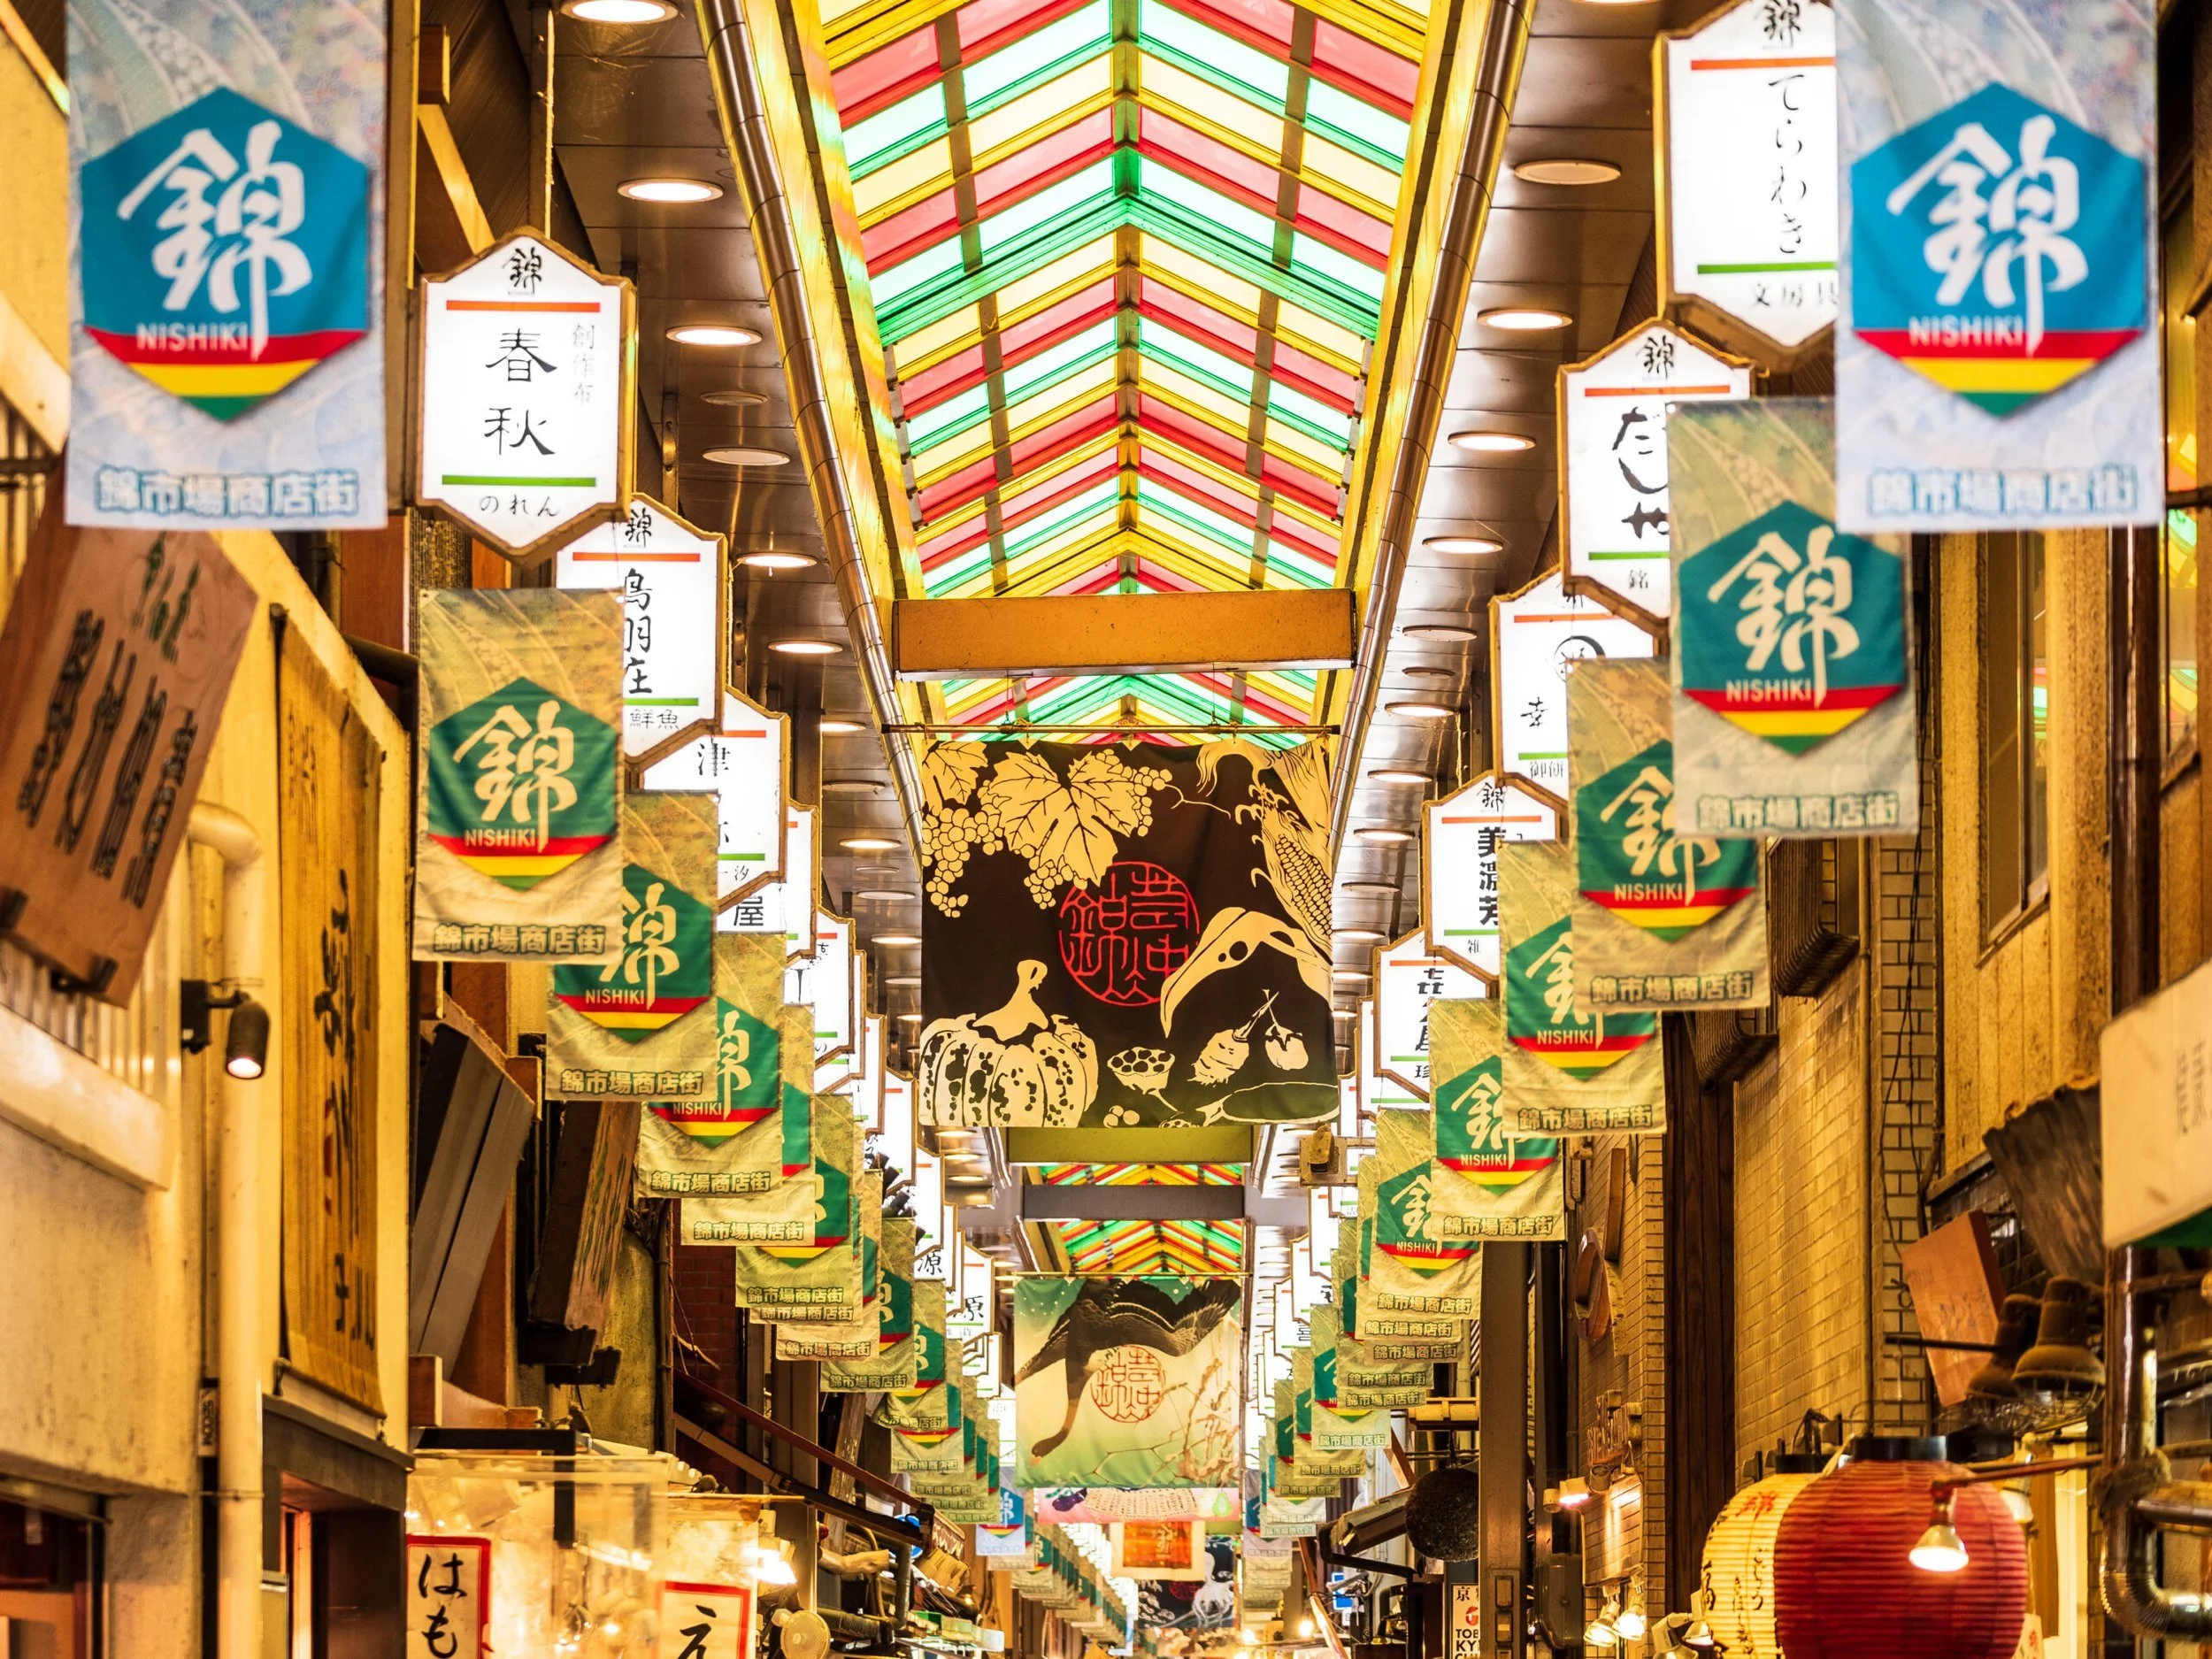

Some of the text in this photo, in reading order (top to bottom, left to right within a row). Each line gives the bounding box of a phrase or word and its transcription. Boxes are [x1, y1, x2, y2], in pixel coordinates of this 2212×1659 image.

[117, 119, 312, 361] 錦
[1887, 115, 2088, 358] 錦
[502, 247, 541, 294] 錦
[136, 322, 249, 353] NISHIKI
[1909, 314, 2024, 348] NISHIKI
[1636, 335, 1675, 379] 錦
[484, 328, 557, 456] 春秋
[95, 464, 361, 519] 錦市場商店街
[1867, 465, 2138, 517] 錦市場商店街
[480, 495, 559, 518] のれん
[1708, 526, 1860, 710] 錦
[1725, 679, 1812, 703] NISHIKI
[629, 709, 680, 729] 鮮魚
[453, 700, 578, 853] 錦
[1696, 793, 1901, 828] 錦市場商店街
[464, 828, 536, 848] NISHIKI
[1613, 883, 1684, 902] NISHIKI
[432, 922, 607, 955] 錦市場商店街
[585, 988, 645, 1005] NISHIKI
[1590, 972, 1754, 1003] 錦市場商店街
[1536, 1030, 1594, 1045] NISHIKI
[559, 1069, 703, 1096] 錦市場商店街
[673, 1102, 723, 1116] NISHIKI
[1517, 1104, 1653, 1132] 錦市場商店街
[1460, 1154, 1508, 1167] NISHIKI
[650, 1171, 772, 1194] 錦市場商店街
[693, 1221, 805, 1241] 錦市場商店街
[1443, 1216, 1554, 1236] 錦市場商店街
[1396, 1240, 1436, 1254] NISHIKI
[746, 1286, 844, 1305] 錦市場商店街
[1377, 1293, 1472, 1315] 錦市場商店街
[760, 1306, 854, 1322] 錦市場商店街
[1364, 1320, 1453, 1337] 錦市場商店街
[785, 1340, 872, 1357] 錦市場商店街
[1373, 1344, 1457, 1360] 錦市場商店街
[829, 1374, 908, 1389] 錦市場商店街
[1348, 1372, 1427, 1387] 錦市場商店街
[1346, 1393, 1420, 1408] 錦市場商店街
[419, 1553, 467, 1659] はも
[1455, 1640, 1481, 1652] KY
